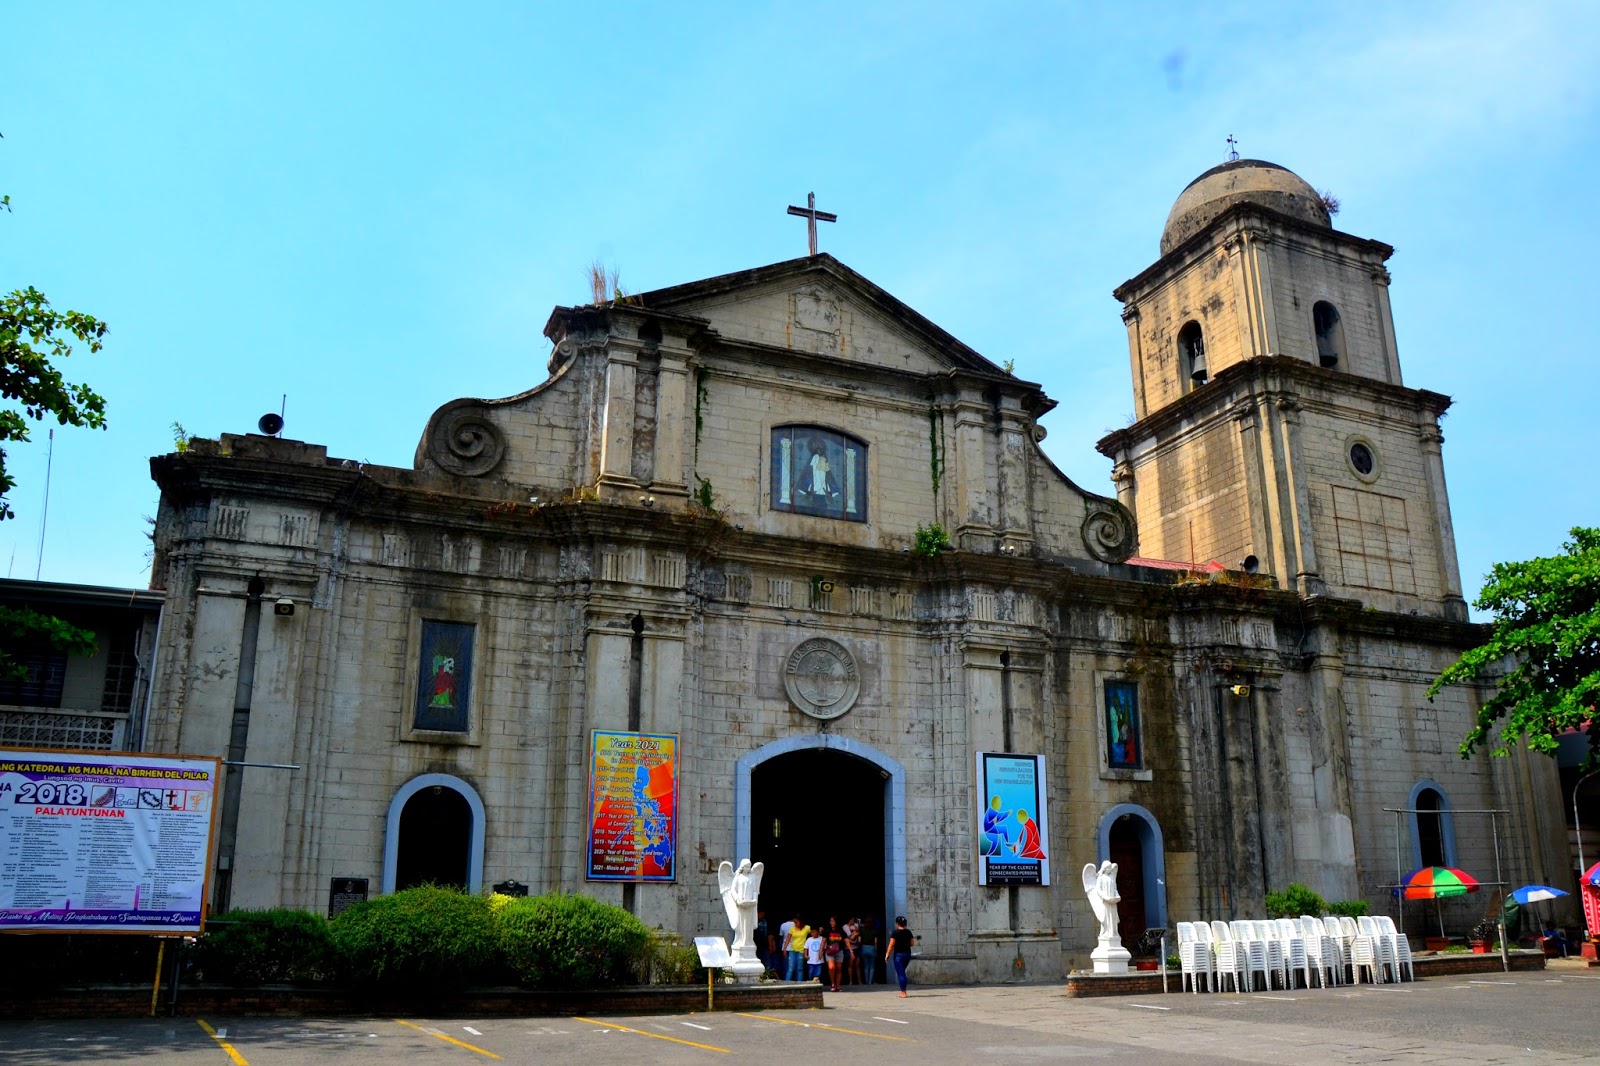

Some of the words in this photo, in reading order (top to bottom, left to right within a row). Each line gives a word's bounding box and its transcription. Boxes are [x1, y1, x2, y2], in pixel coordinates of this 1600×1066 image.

[610, 738, 633, 748] Year
[635, 740, 660, 750] 2021
[17, 763, 66, 773] KATEDRAL
[67, 765, 81, 774] NG
[82, 766, 114, 775] MAHAL
[116, 768, 129, 776] NA
[131, 768, 163, 778] BIRHEN
[164, 770, 181, 779] DEL
[183, 771, 208, 780] PILAR
[43, 774, 73, 782] Lungsod
[19, 783, 84, 805] 2018
[35, 806, 125, 817] PALATUNTUNAN
